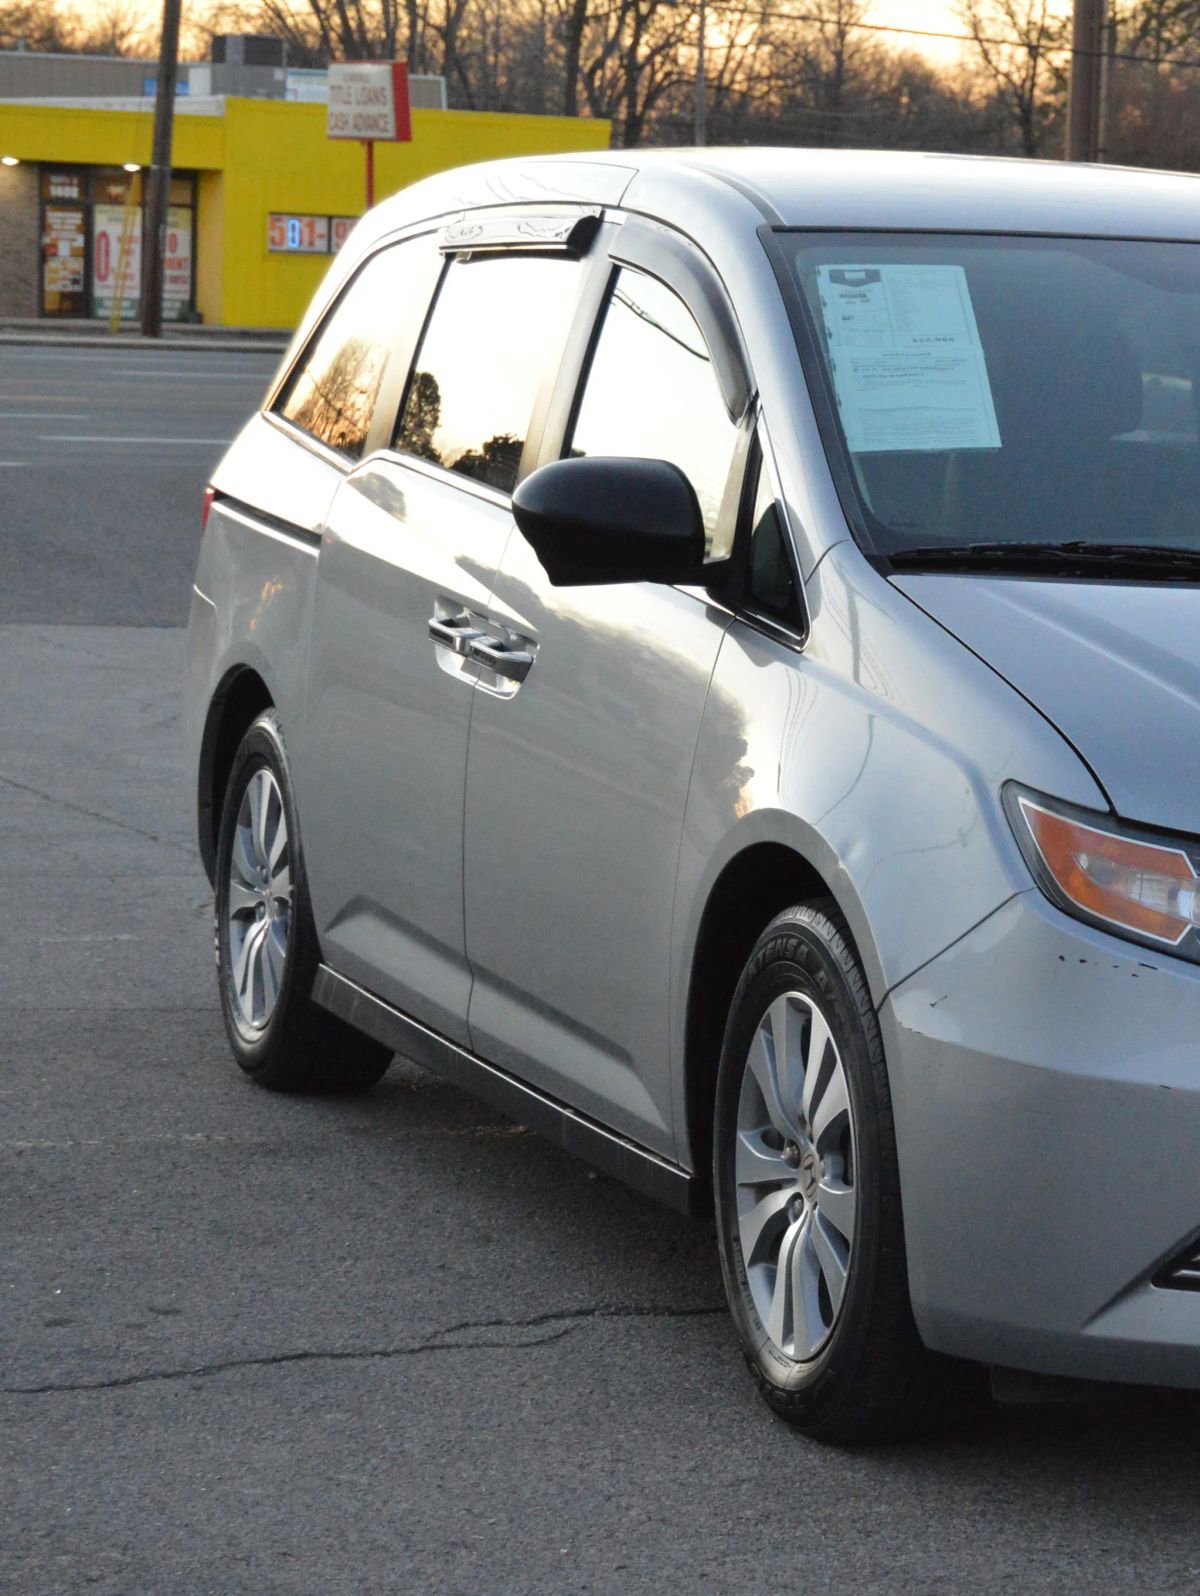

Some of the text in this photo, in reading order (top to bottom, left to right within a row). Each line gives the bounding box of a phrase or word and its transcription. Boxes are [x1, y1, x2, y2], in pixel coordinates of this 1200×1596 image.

[330, 85, 387, 107] TITLE LOANS
[329, 112, 391, 133] CASH ADVANCE
